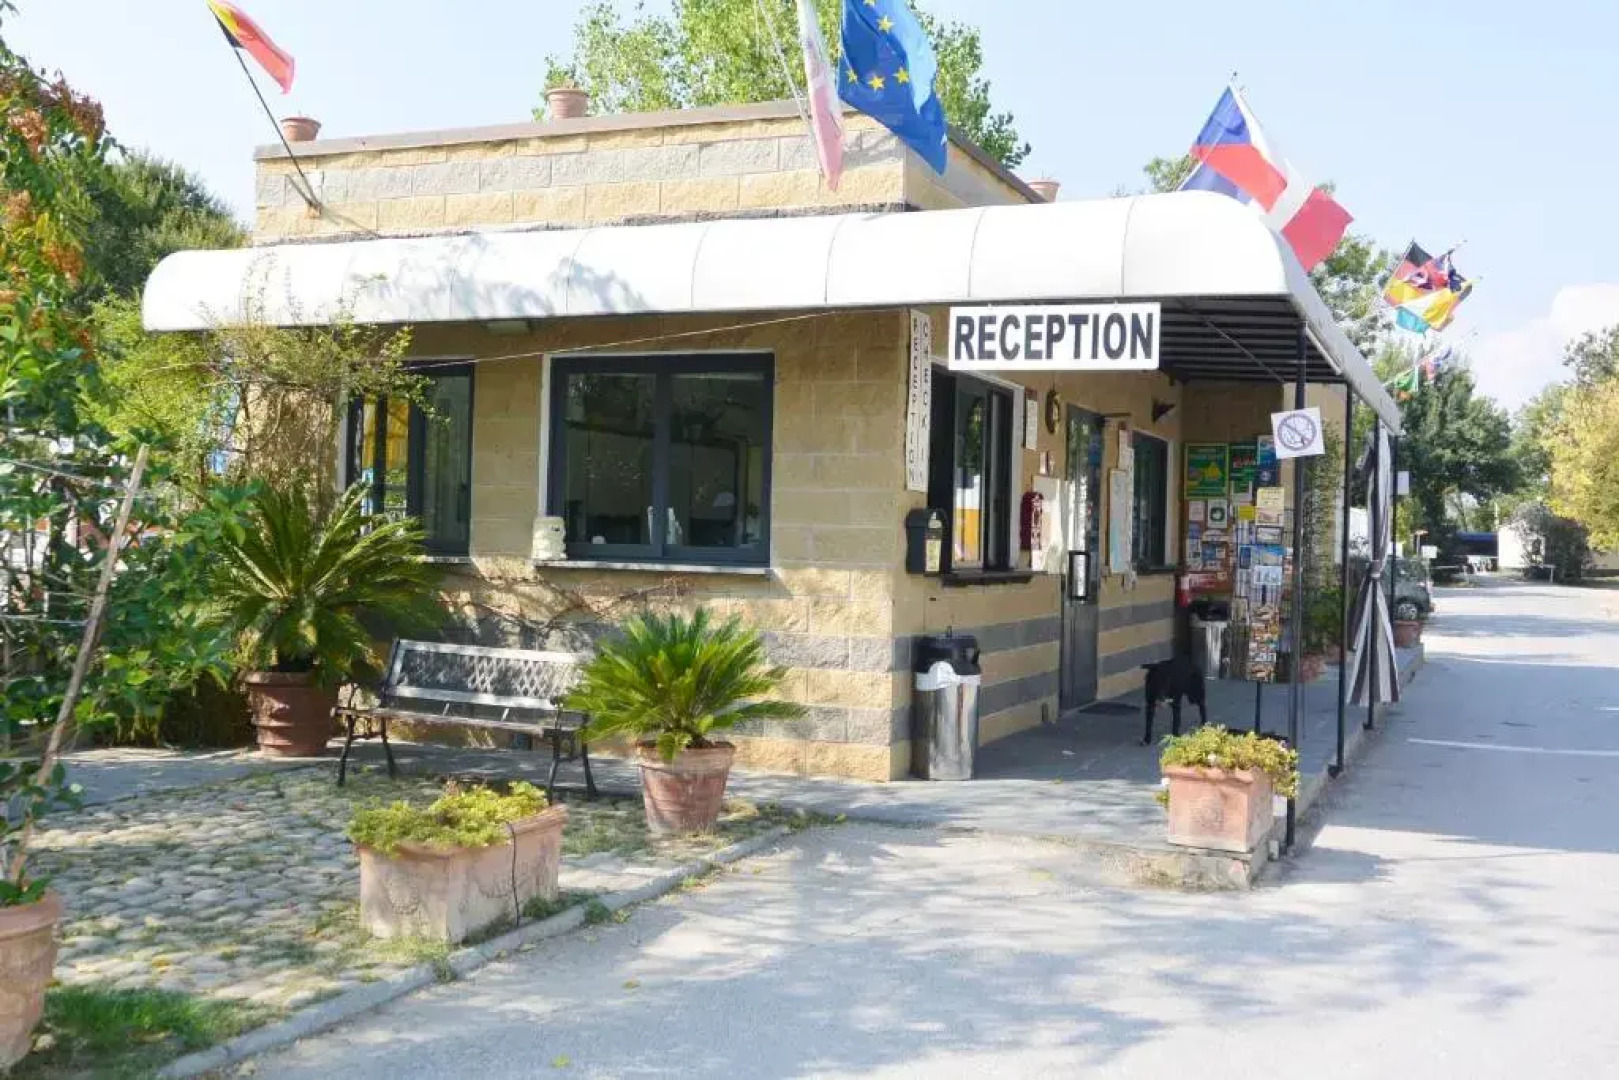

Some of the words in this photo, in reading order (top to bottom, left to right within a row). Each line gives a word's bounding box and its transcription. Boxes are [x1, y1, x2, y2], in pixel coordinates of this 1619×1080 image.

[921, 321, 929, 430] CHECK
[954, 312, 1154, 361] RECEPTION
[909, 317, 918, 482] RECEPTION
